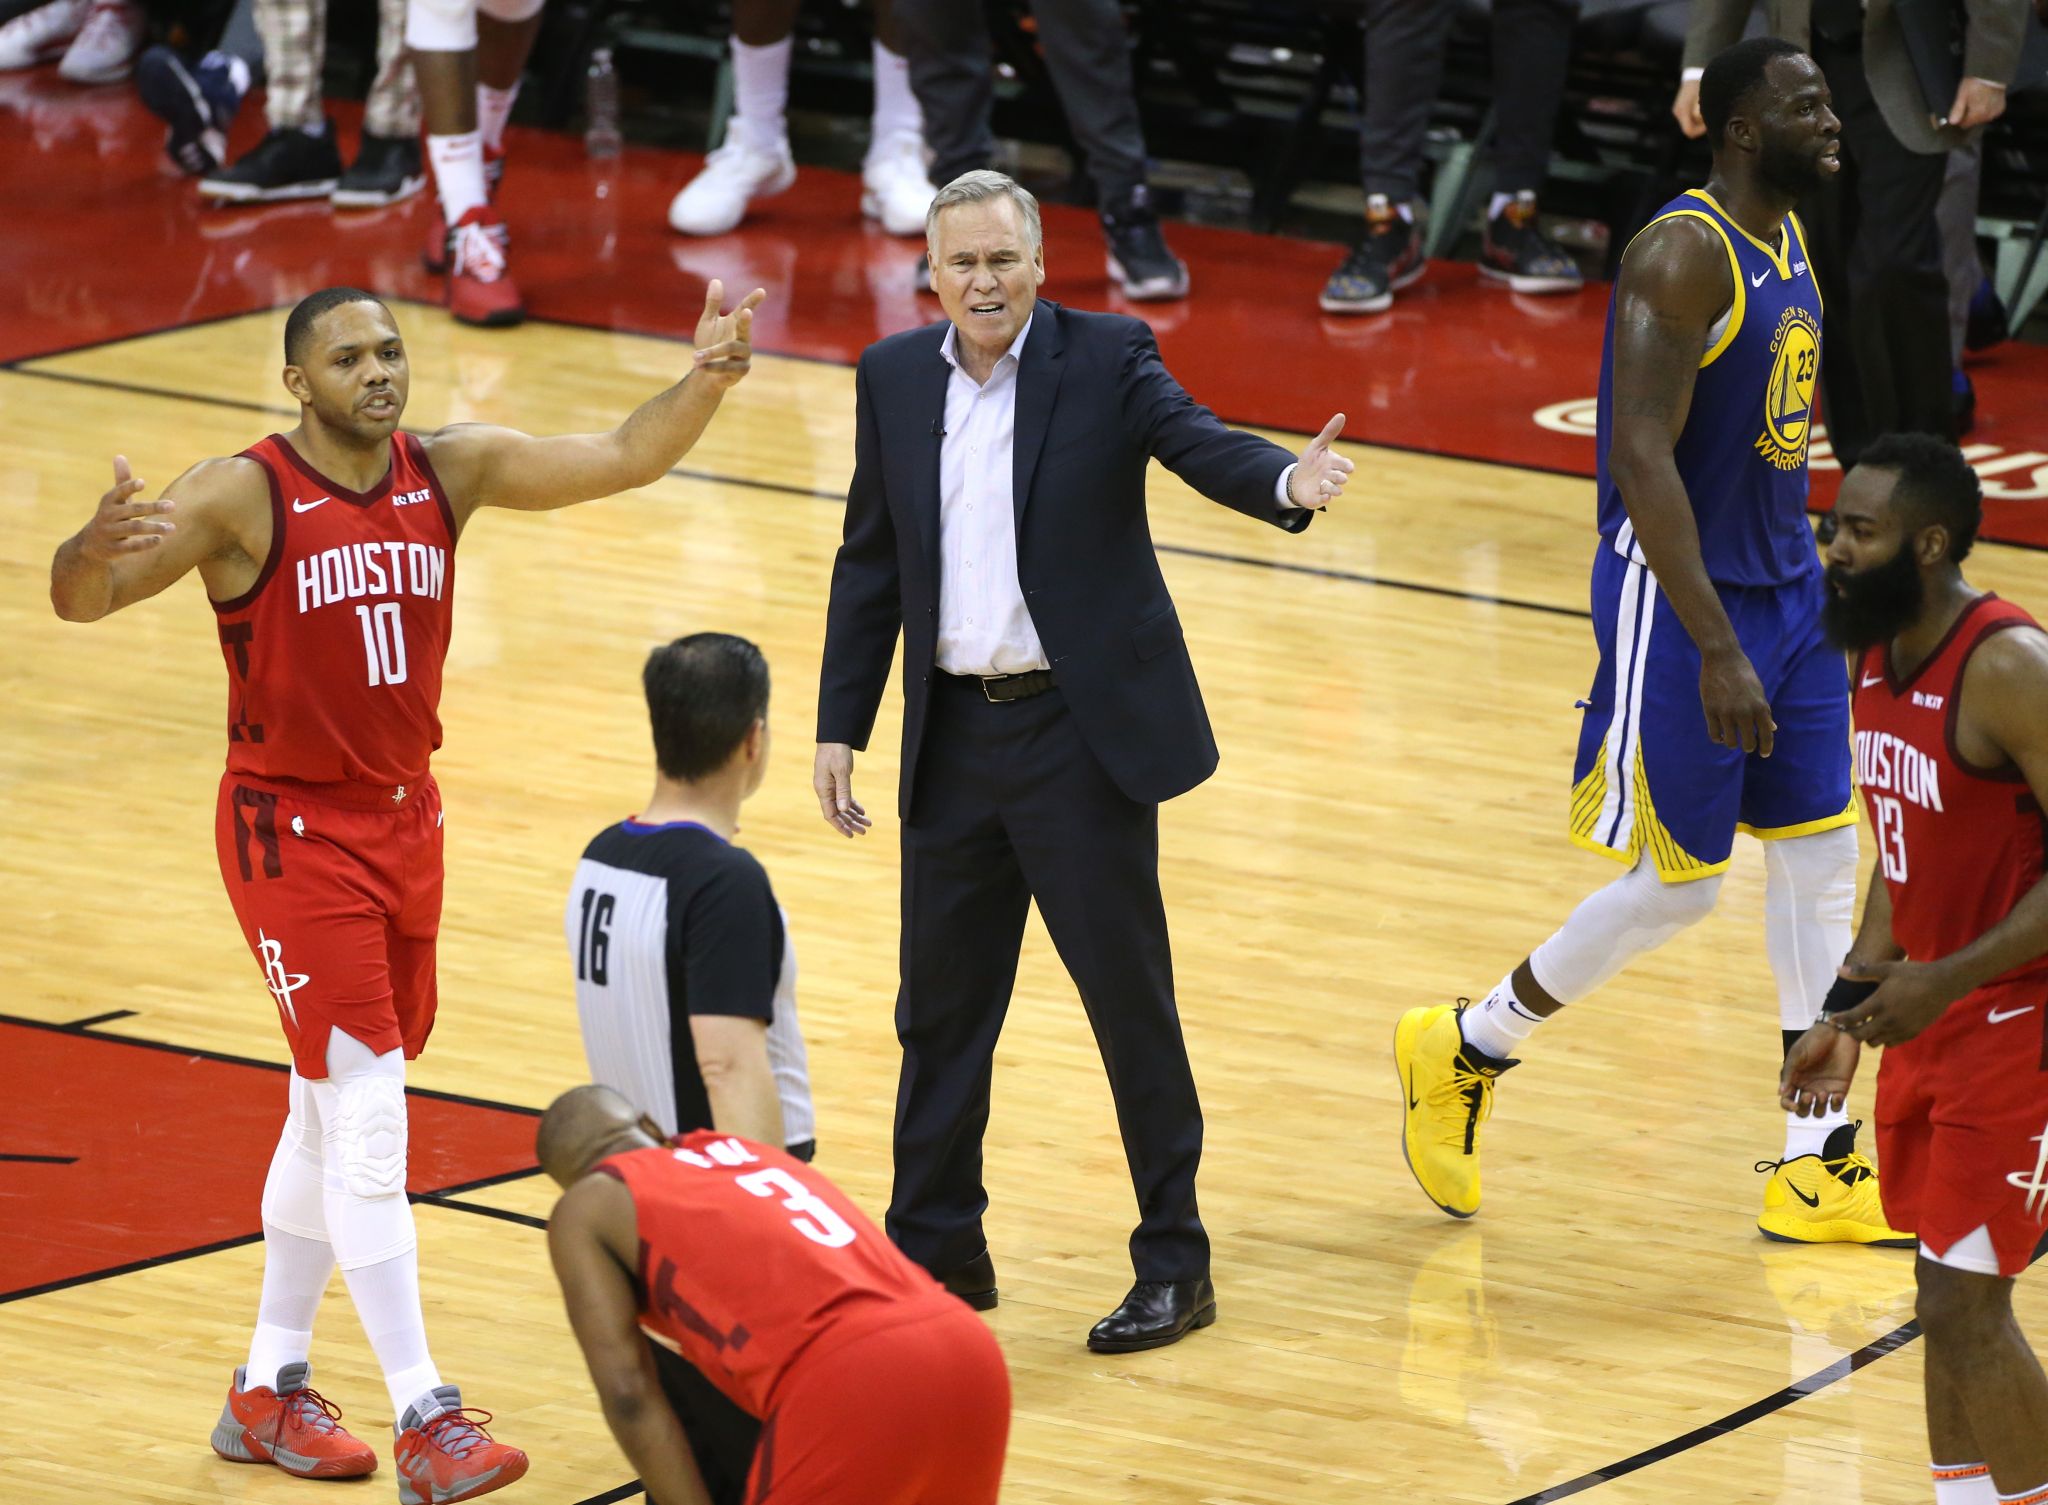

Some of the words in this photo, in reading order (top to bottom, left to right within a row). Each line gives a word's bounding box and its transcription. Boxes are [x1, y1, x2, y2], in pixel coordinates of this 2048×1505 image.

[1770, 306, 1796, 352] GOLDEN
[1797, 307, 1822, 343] STATE
[1796, 348, 1815, 383] 23
[1754, 430, 1808, 471] WARRIO
[296, 541, 446, 614] HOUSTON
[355, 601, 408, 687] 10
[1854, 730, 1944, 813] OUSTON
[1872, 793, 1908, 884] 13
[578, 888, 615, 986] 16
[735, 1168, 857, 1249] 3
